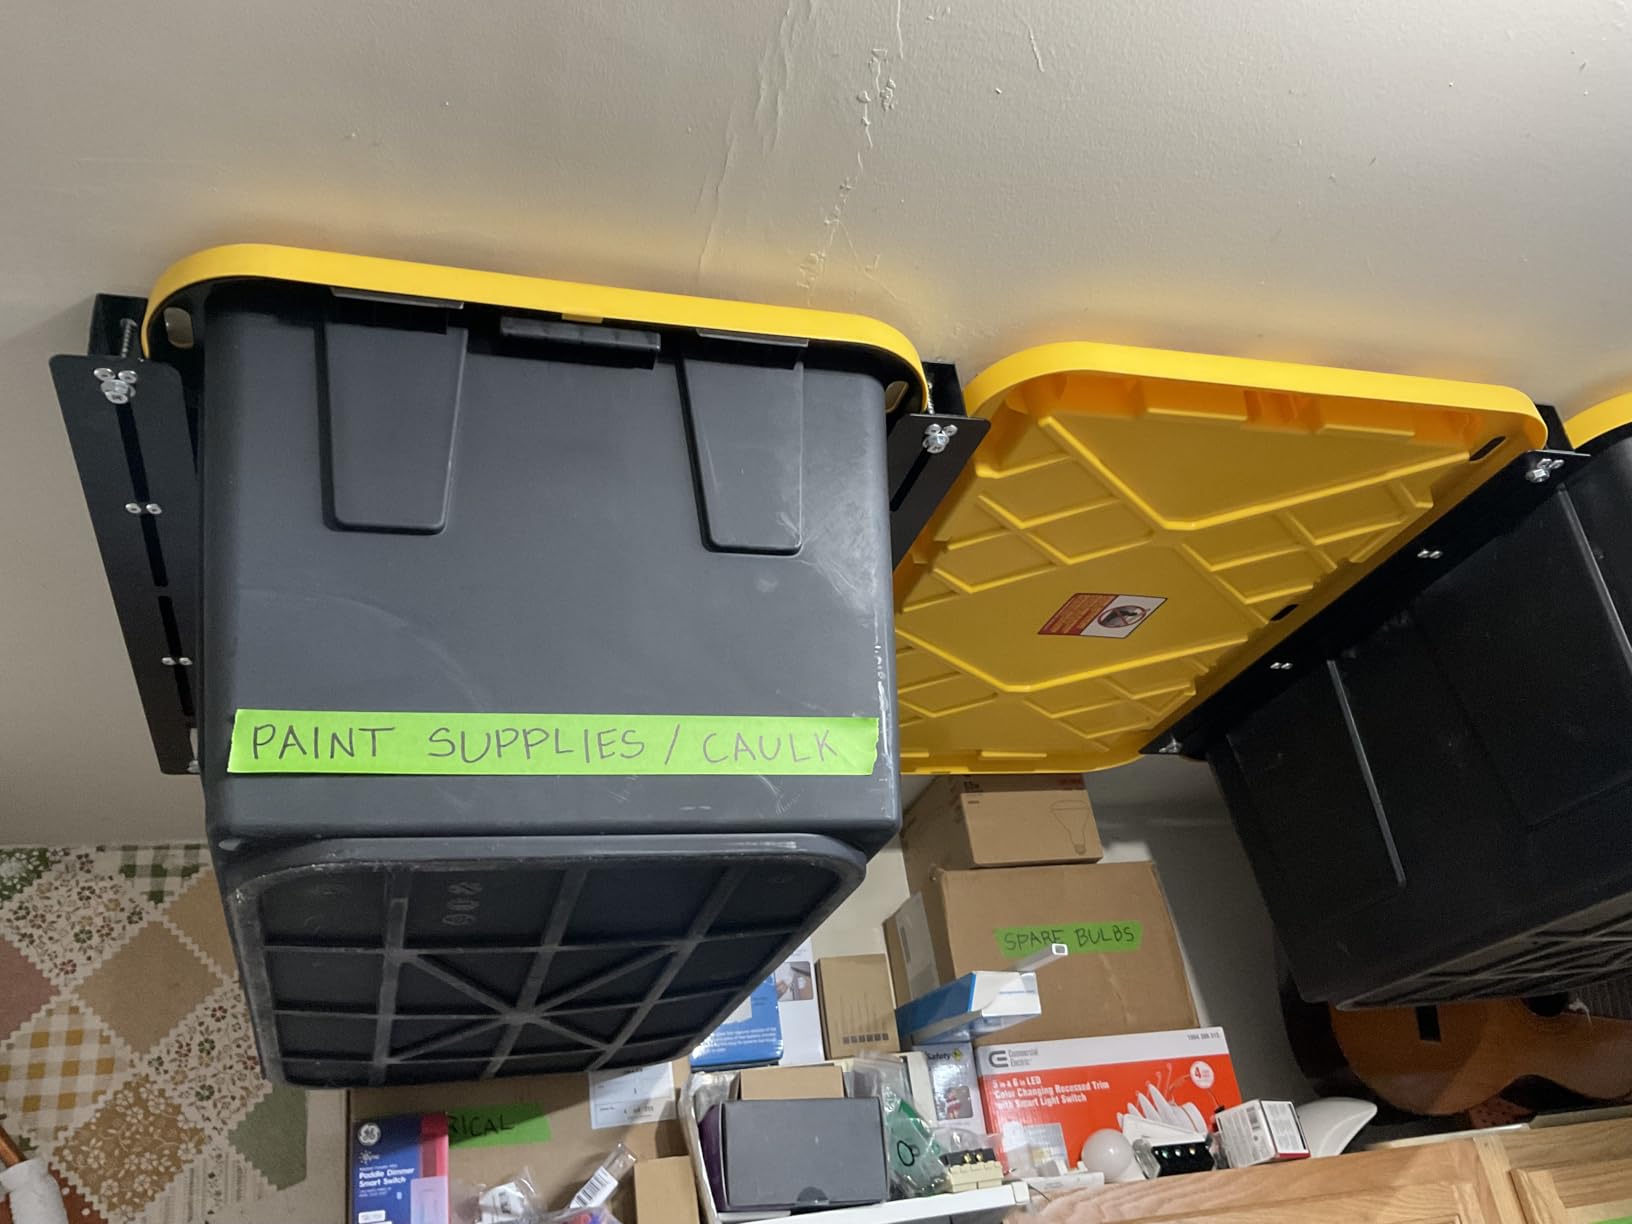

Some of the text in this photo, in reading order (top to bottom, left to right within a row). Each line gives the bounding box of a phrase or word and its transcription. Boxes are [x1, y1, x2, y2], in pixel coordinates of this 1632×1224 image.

[252, 724, 838, 765] PAINT SUPPLIES / CAULK
[1003, 925, 1135, 951] SPARE BULBS
[1026, 1075, 1042, 1085] LED
[994, 1080, 1109, 1099] Color Changing Recessed Trim
[1015, 1097, 1039, 1108] Smart
[1040, 1094, 1060, 1107] Light
[1061, 1092, 1087, 1104] Switch
[359, 1169, 385, 1179] Paddle
[387, 1167, 415, 1177] Dimmer
[359, 1176, 406, 1188] Smart Switch
